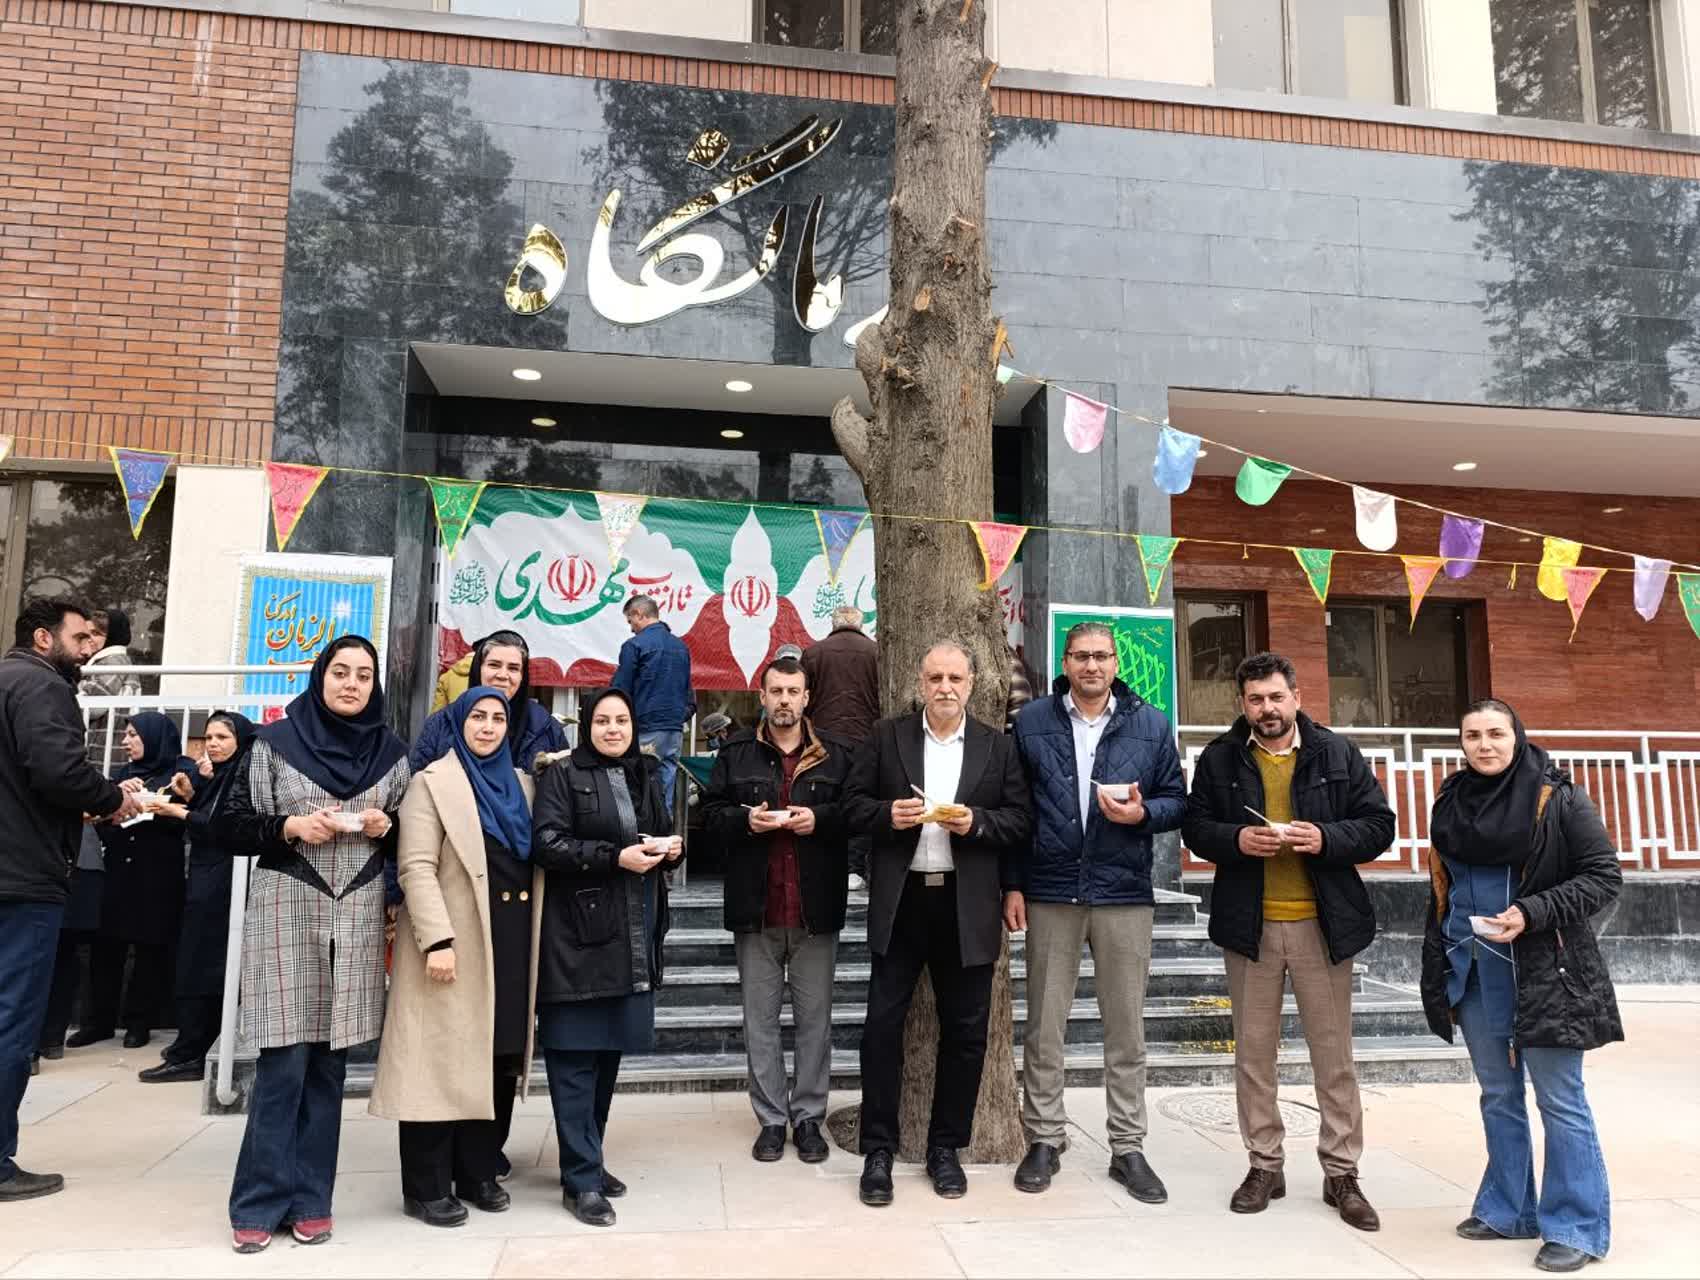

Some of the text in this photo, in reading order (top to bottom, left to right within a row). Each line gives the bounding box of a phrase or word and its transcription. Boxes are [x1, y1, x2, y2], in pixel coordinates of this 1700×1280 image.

[505, 112, 890, 348] مانگاه
[495, 551, 629, 626] مهدی
[678, 584, 692, 611] تا
[265, 615, 336, 651] الزمان
